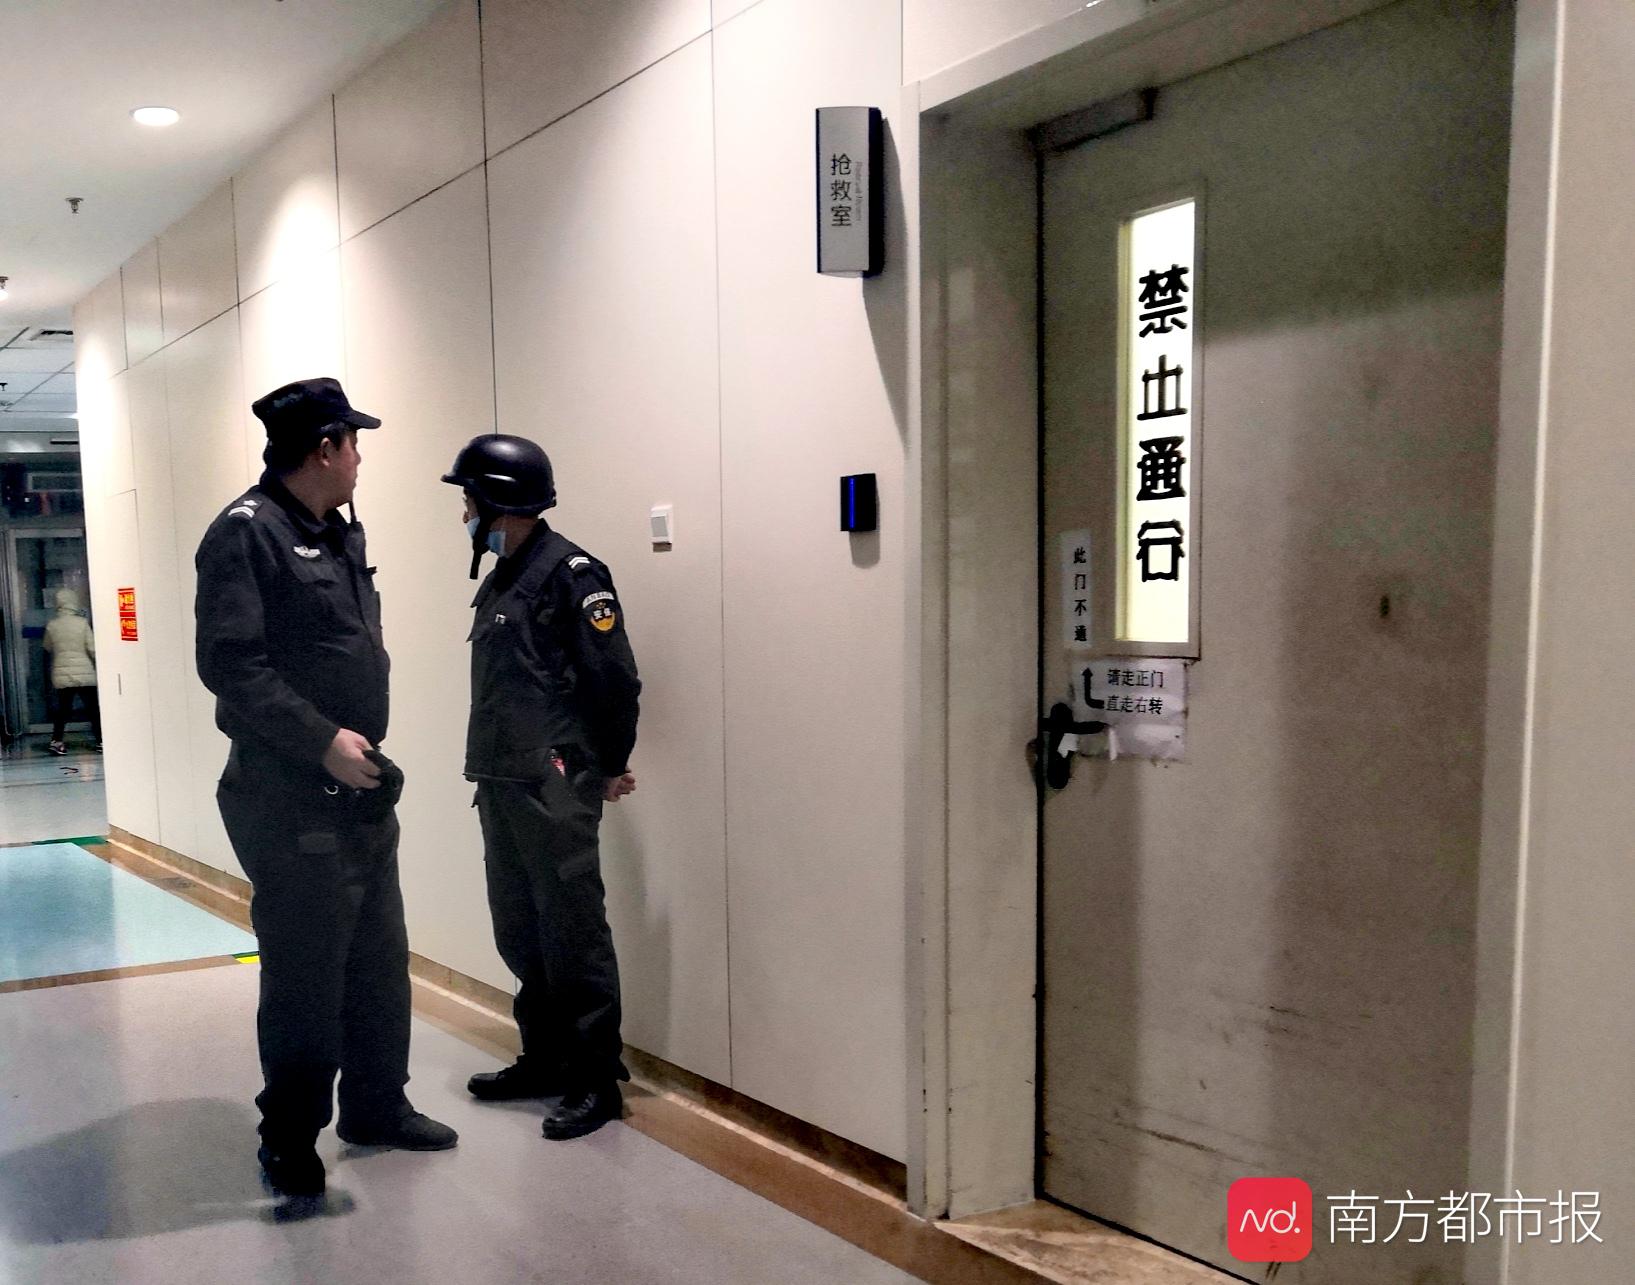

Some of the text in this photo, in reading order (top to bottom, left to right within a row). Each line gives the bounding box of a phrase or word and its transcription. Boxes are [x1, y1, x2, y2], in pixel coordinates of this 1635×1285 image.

[830, 153, 852, 227] 抢救室
[1072, 546, 1088, 642] 此门不通
[1106, 668, 1164, 689] 请走正门
[1105, 695, 1163, 715] 直走右转
